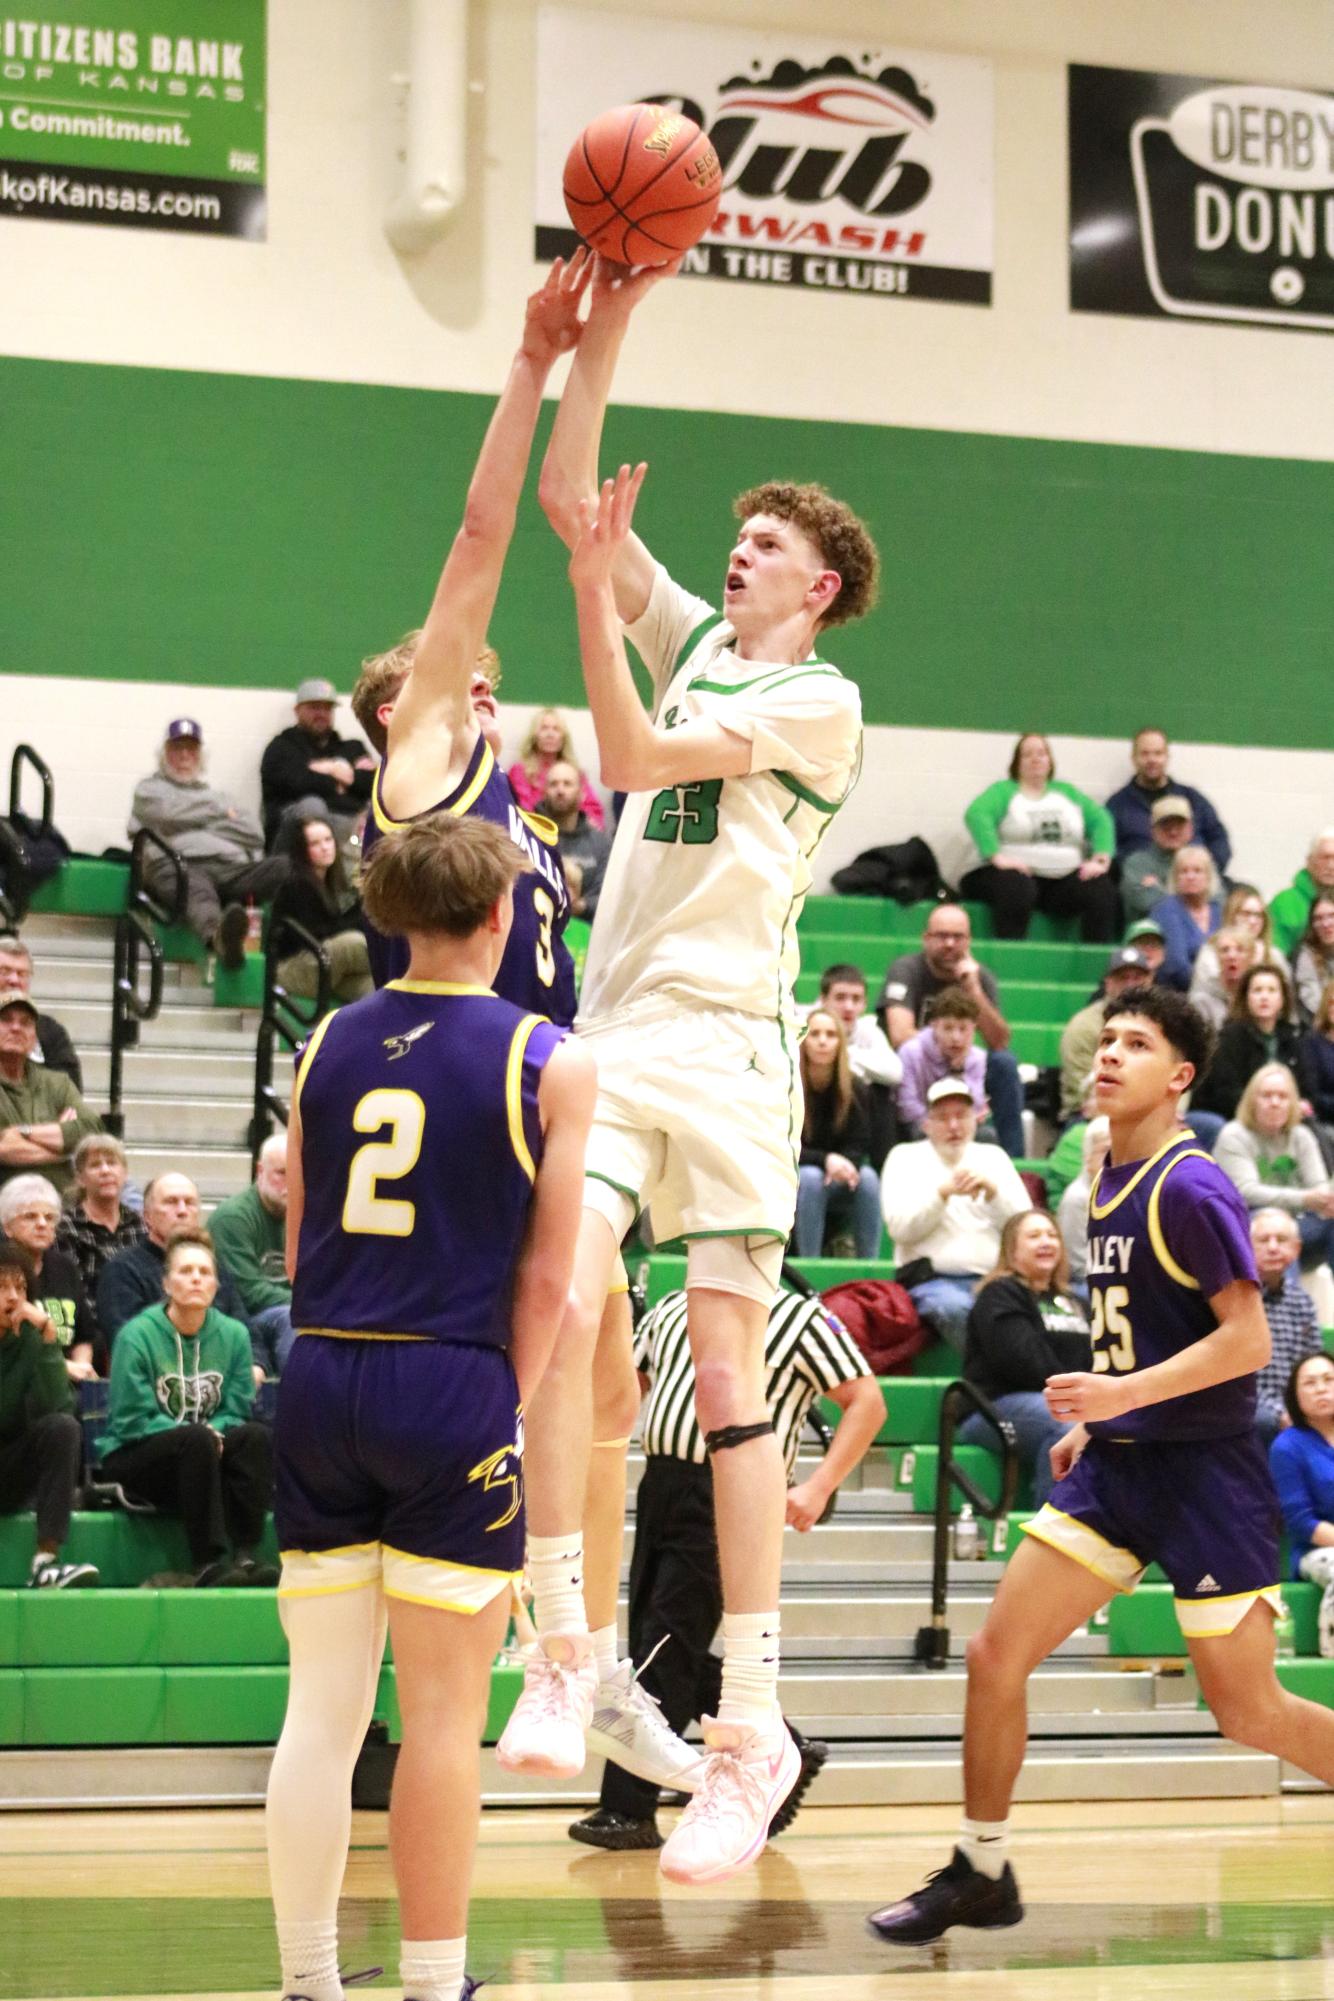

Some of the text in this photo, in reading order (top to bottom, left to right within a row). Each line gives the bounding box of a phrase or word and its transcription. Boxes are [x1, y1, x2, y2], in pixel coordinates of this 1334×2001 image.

[151, 34, 243, 81] BANK
[3, 63, 245, 102] OF KANSAS
[10, 106, 191, 147] Commitment.
[722, 249, 793, 282] THE
[804, 256, 909, 294] CLUB!
[642, 777, 724, 845] 23
[533, 887, 556, 988] 3
[342, 1088, 426, 1237] 2
